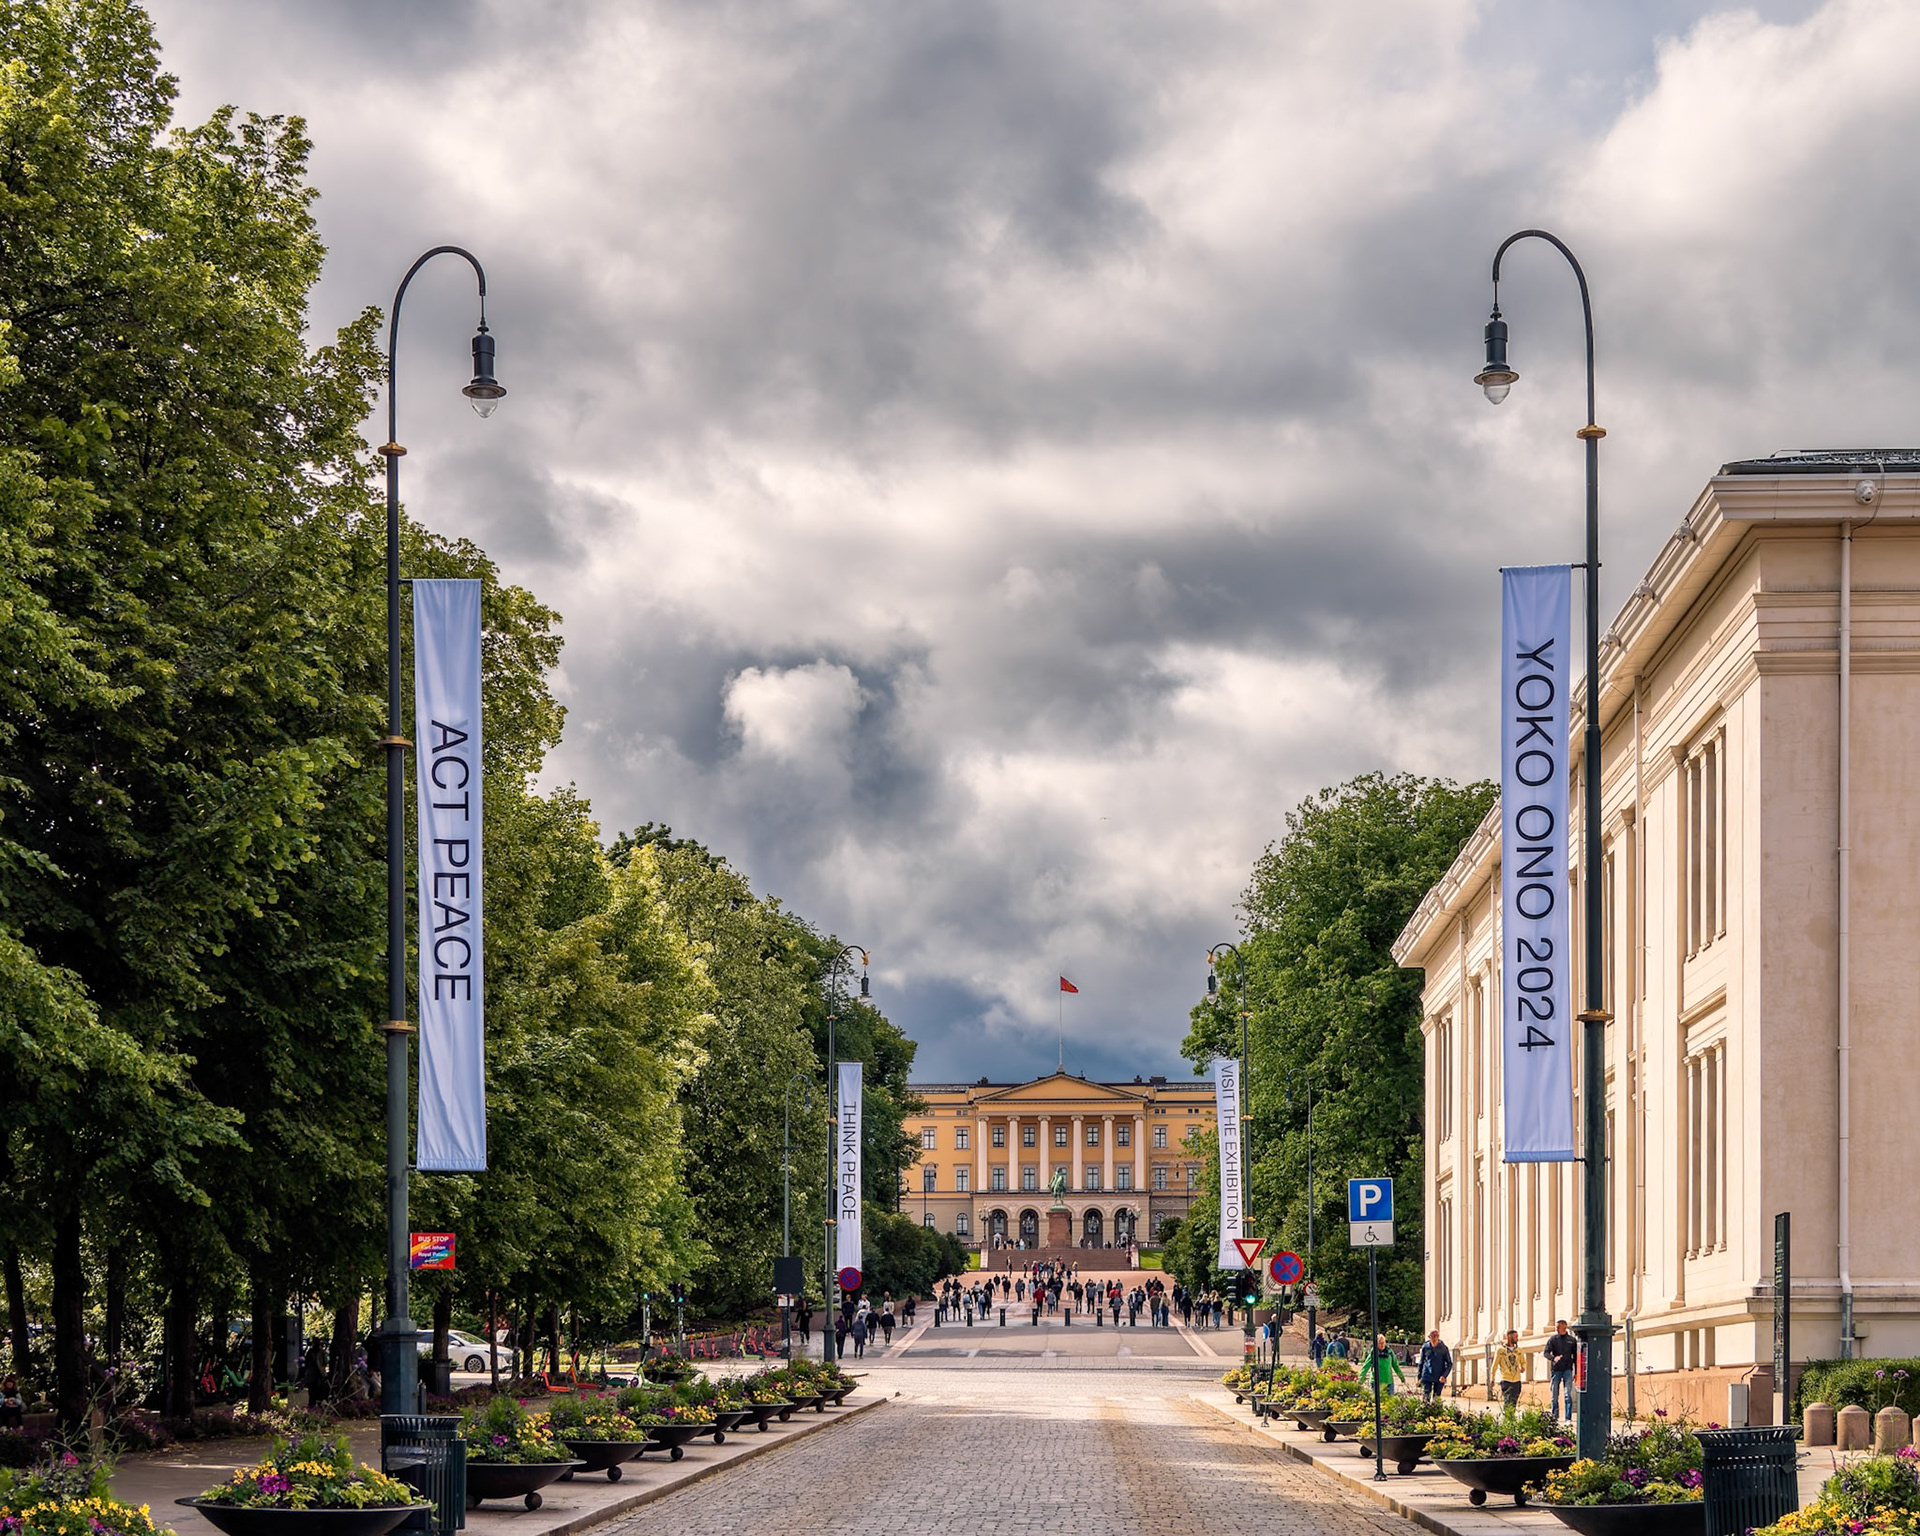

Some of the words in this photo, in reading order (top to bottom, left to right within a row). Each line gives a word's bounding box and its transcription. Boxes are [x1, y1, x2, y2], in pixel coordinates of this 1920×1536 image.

[1515, 638, 1555, 787] YOKO
[430, 719, 470, 822] ACT
[1514, 804, 1556, 920] ONO
[433, 838, 472, 1001] PEACE
[1517, 936, 1556, 1053] 2024
[1220, 1064, 1235, 1102] VISIT
[1223, 1105, 1237, 1137] THE
[842, 1101, 857, 1156] THINK
[842, 1161, 857, 1220] PEACE
[1225, 1141, 1239, 1230] EXHIBITION
[1359, 1184, 1382, 1217] P
